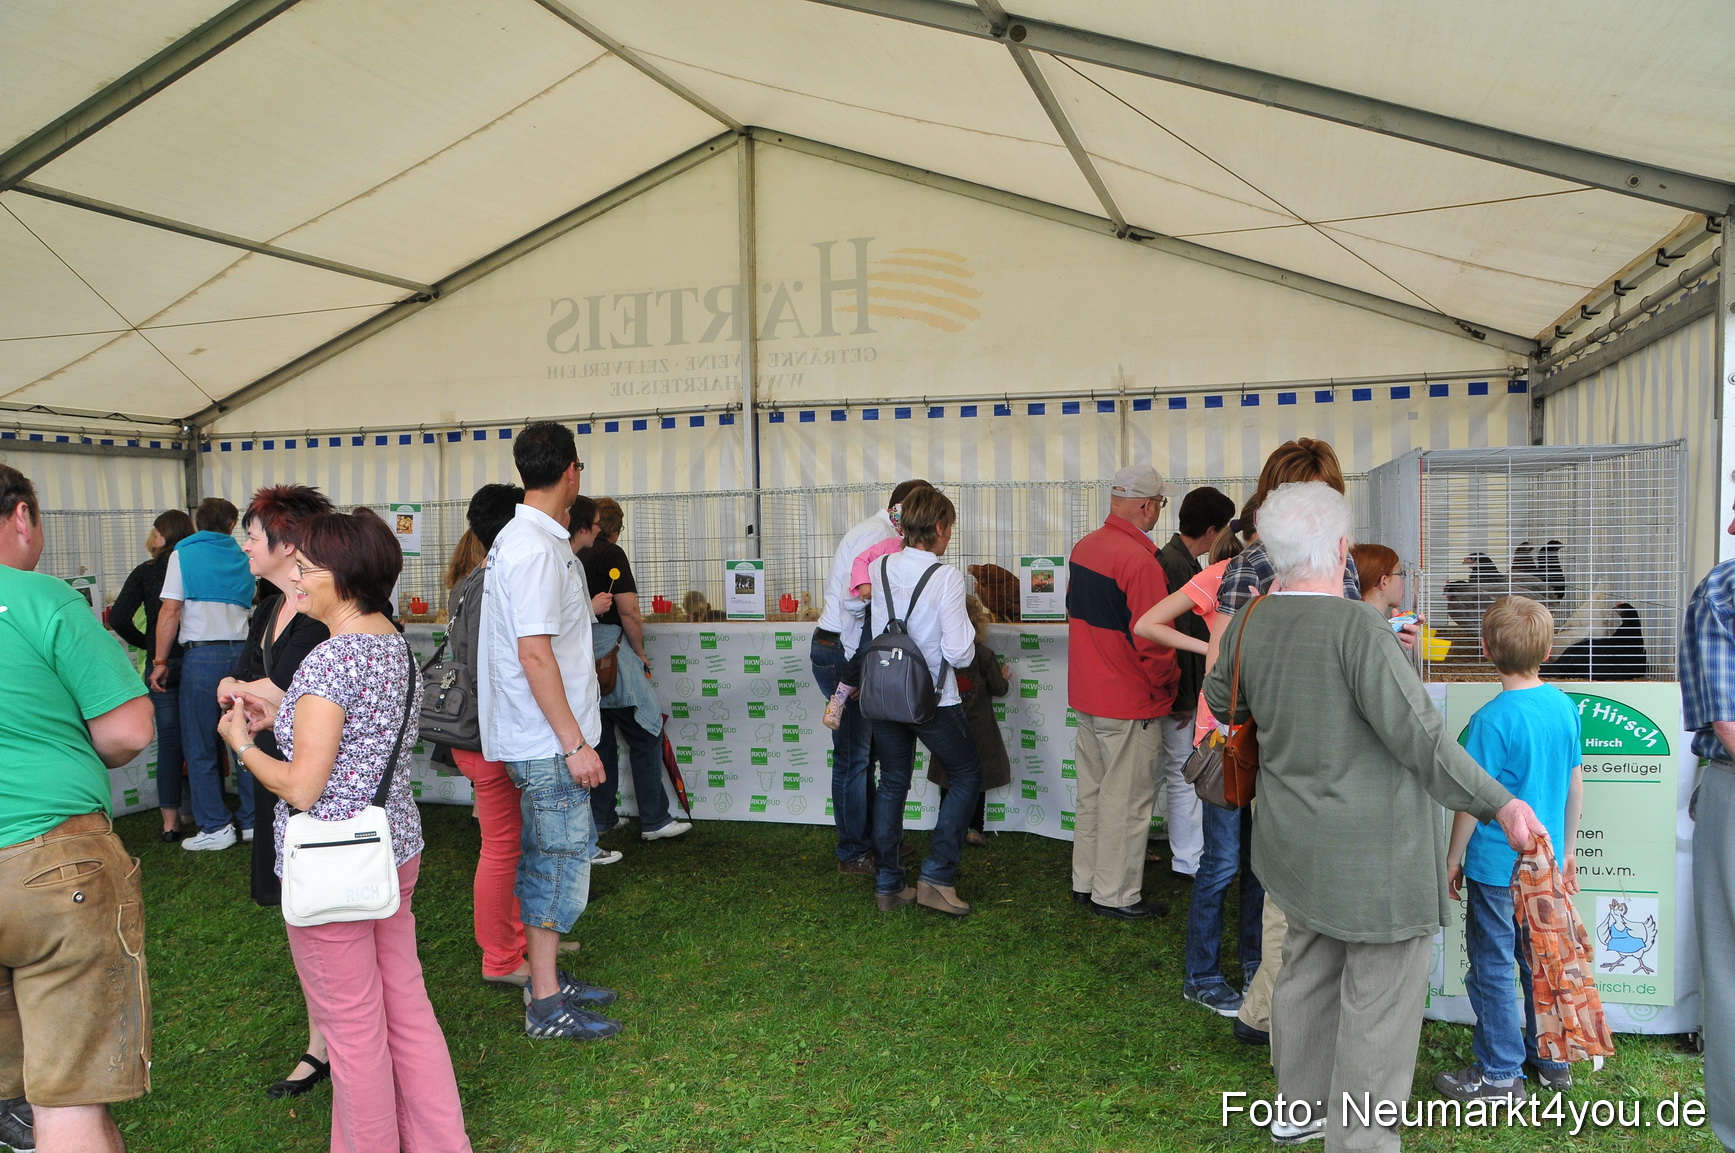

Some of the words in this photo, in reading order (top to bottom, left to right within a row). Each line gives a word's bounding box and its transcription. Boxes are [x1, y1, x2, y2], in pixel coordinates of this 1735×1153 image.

[1592, 702, 1659, 748] Hirsch
[1585, 738, 1623, 748] Hirsch
[1602, 762, 1661, 776] Geflügel
[1592, 866, 1636, 876] u.v.m.
